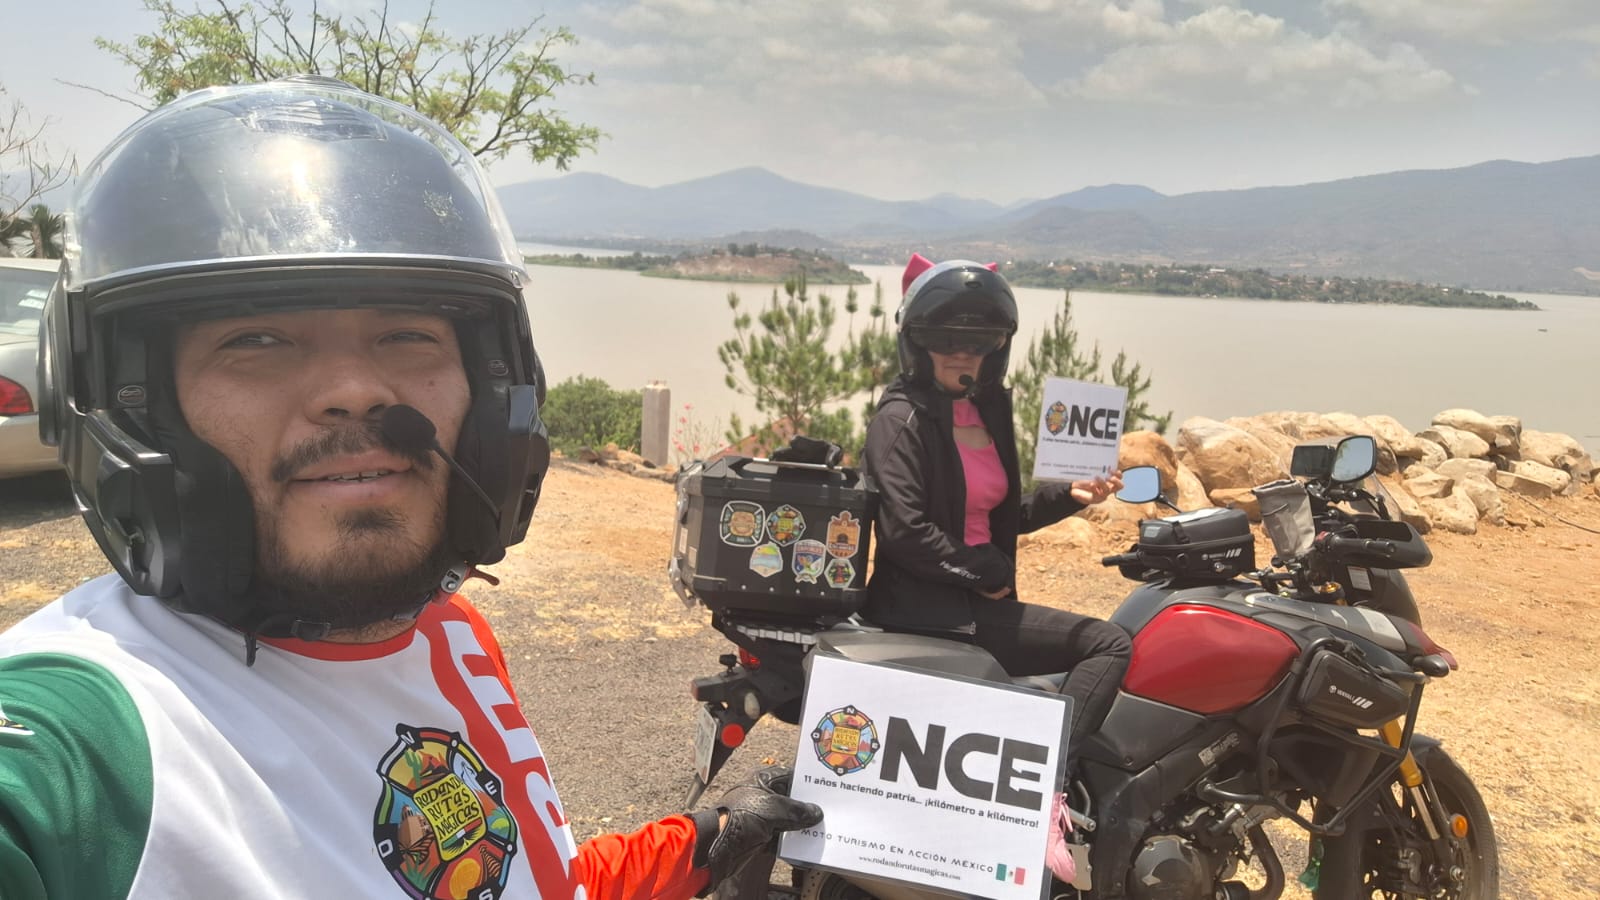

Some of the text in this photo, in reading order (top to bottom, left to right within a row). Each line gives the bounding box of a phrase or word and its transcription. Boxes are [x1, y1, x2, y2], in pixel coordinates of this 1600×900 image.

[1068, 405, 1120, 440] NCE
[880, 716, 1048, 811] NCE
[804, 774, 812, 783] 11
[814, 777, 837, 788] años
[840, 781, 884, 797] haciendo
[924, 798, 976, 815] ¡kilómetro
[978, 809, 985, 817] a
[987, 810, 1039, 829] kilómetro!
[801, 829, 833, 840] MOTO
[838, 835, 886, 851] TURISMO
[889, 845, 904, 855] EN
[908, 849, 947, 863] ACCIÓN
